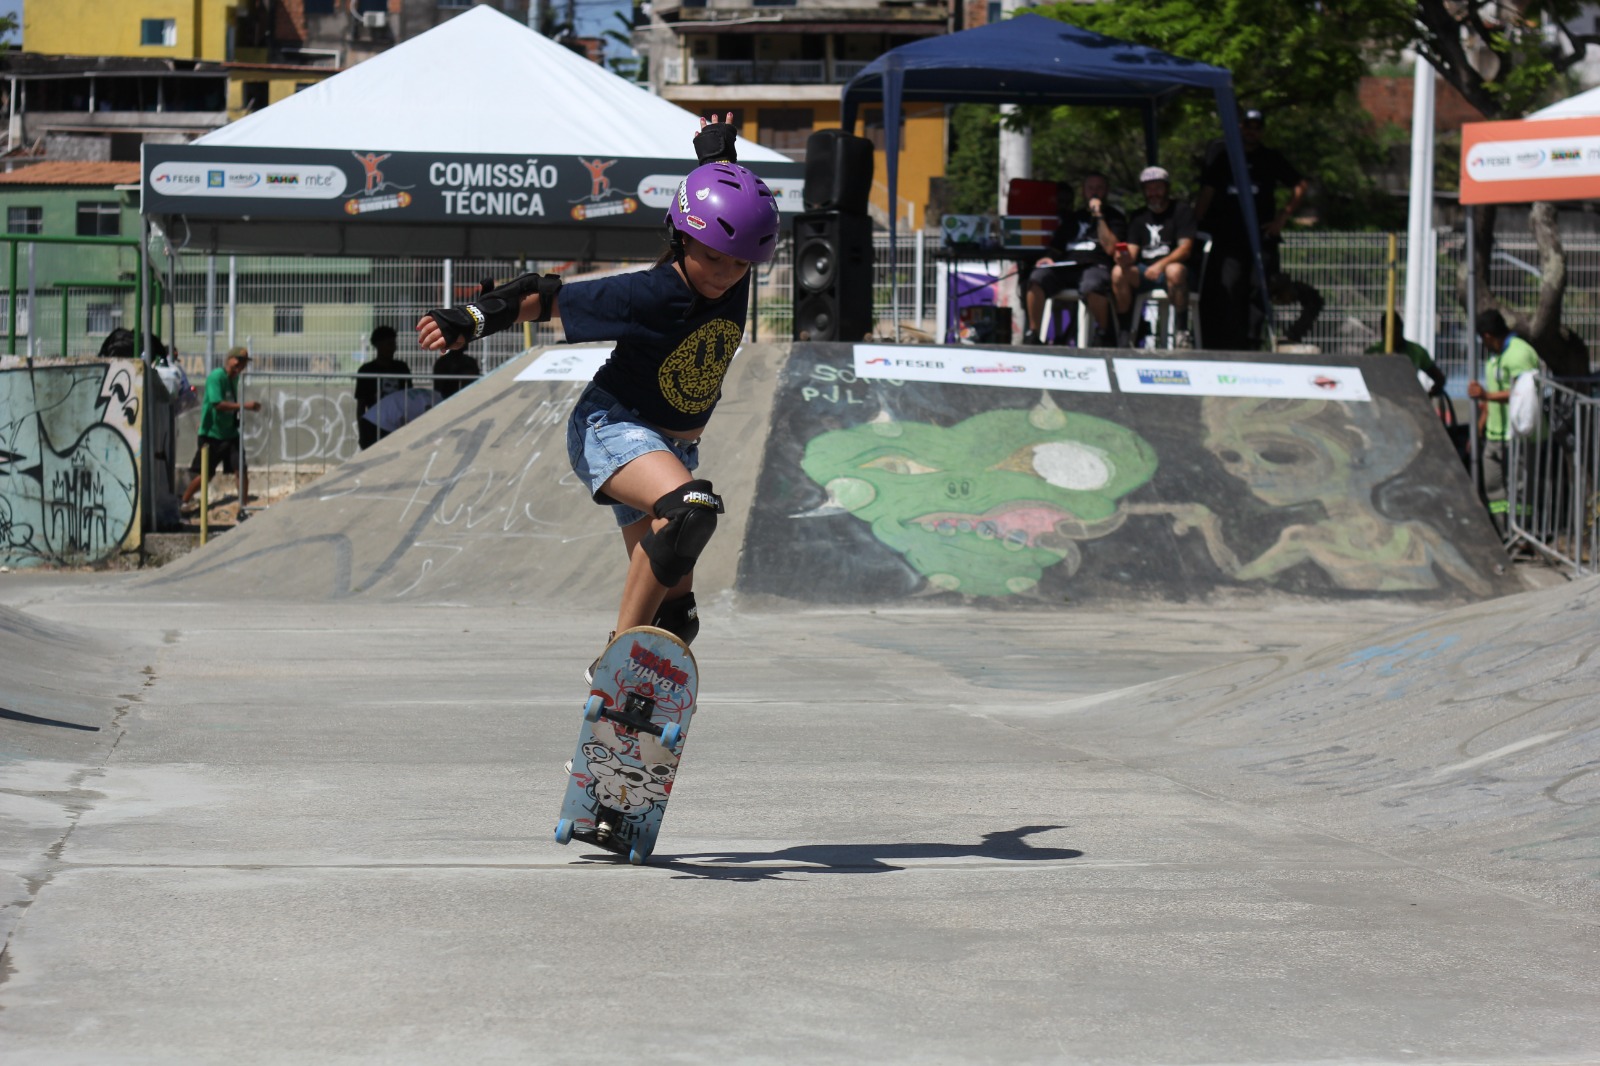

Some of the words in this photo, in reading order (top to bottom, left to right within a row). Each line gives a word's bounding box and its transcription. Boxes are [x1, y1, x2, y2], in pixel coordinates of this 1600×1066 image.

[172, 175, 200, 184] FESEB
[429, 158, 558, 189] COMISSÃO
[442, 184, 545, 217] TÉCNICA
[660, 187, 675, 196] FES
[895, 359, 945, 369] FESEB
[1043, 367, 1090, 381] mte
